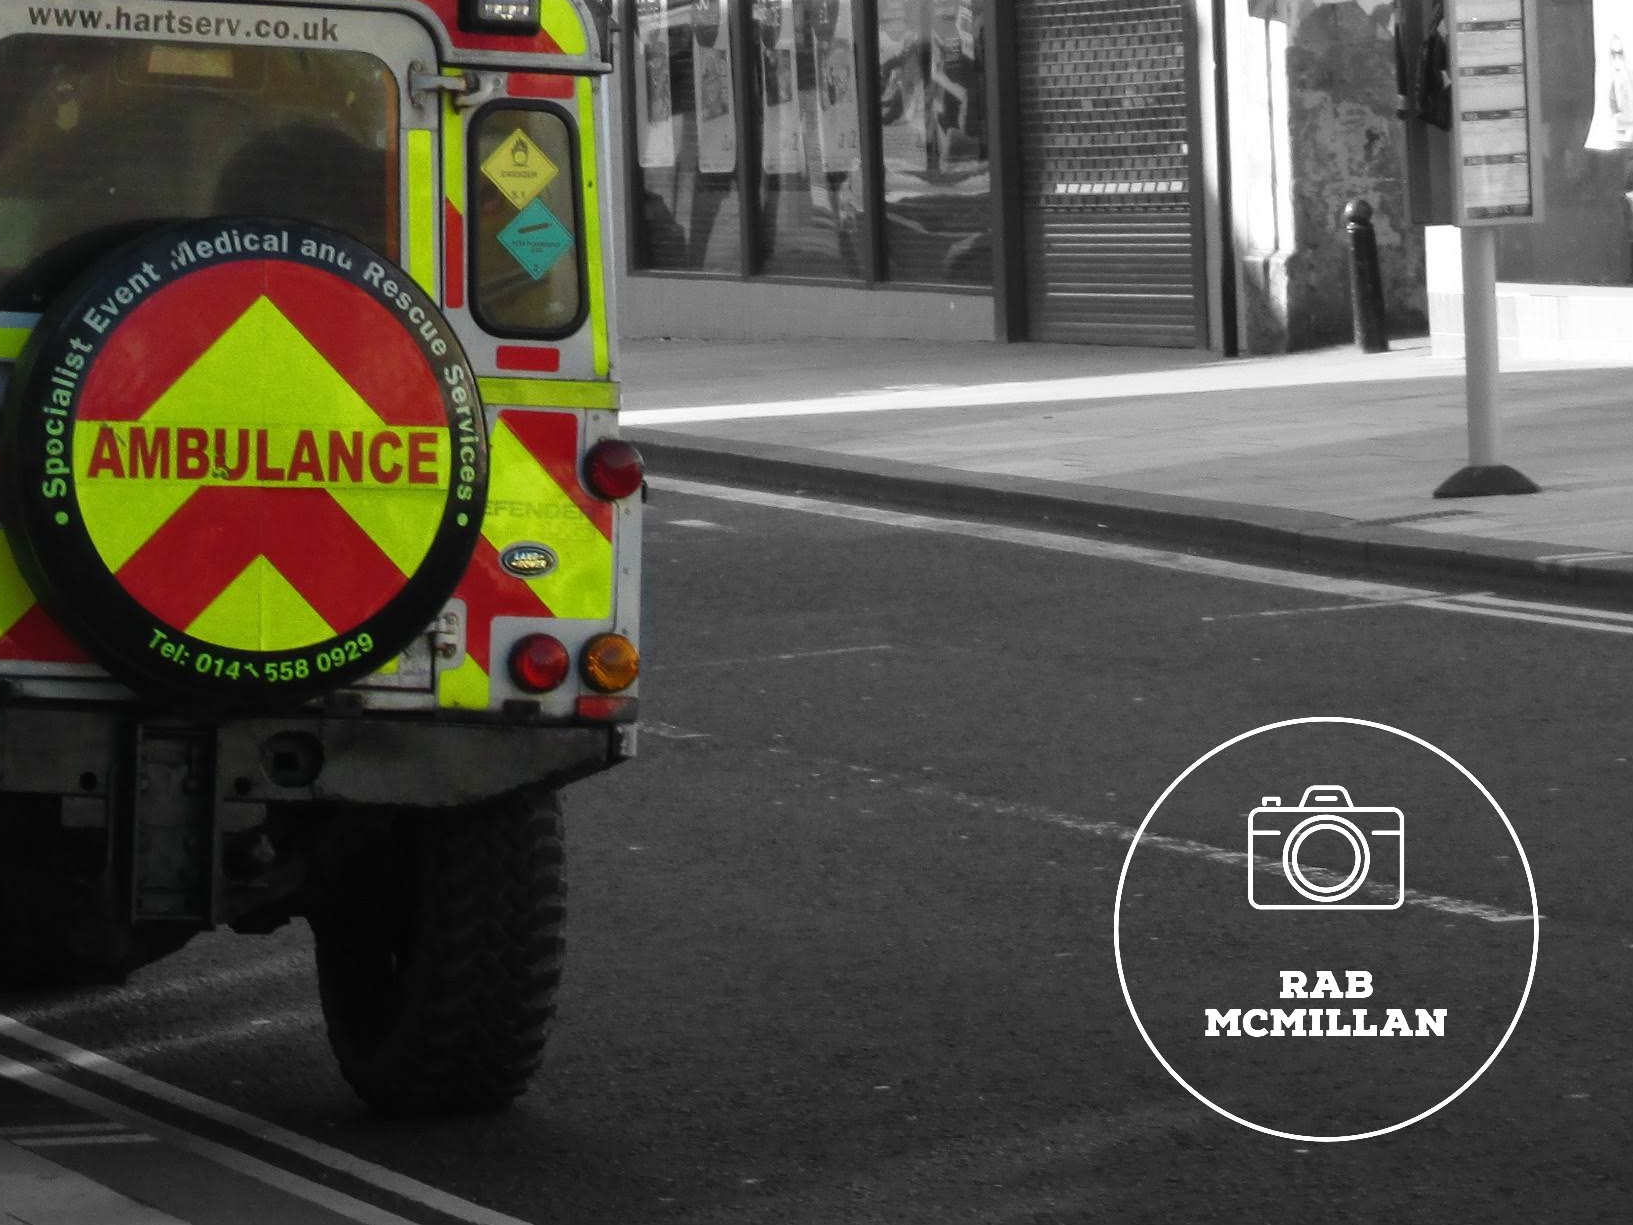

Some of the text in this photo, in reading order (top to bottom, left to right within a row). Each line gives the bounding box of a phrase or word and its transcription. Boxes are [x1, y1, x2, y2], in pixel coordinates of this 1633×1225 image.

[28, 6, 339, 43] www.hartserv.co.uk
[82, 260, 161, 333] Event
[171, 230, 289, 271] Medical
[363, 261, 447, 357] Rescue
[443, 363, 480, 501] Services
[85, 426, 439, 485] AMBULANCE
[147, 629, 190, 665] Tel:
[264, 658, 310, 683] 558
[316, 632, 374, 673] 0929
